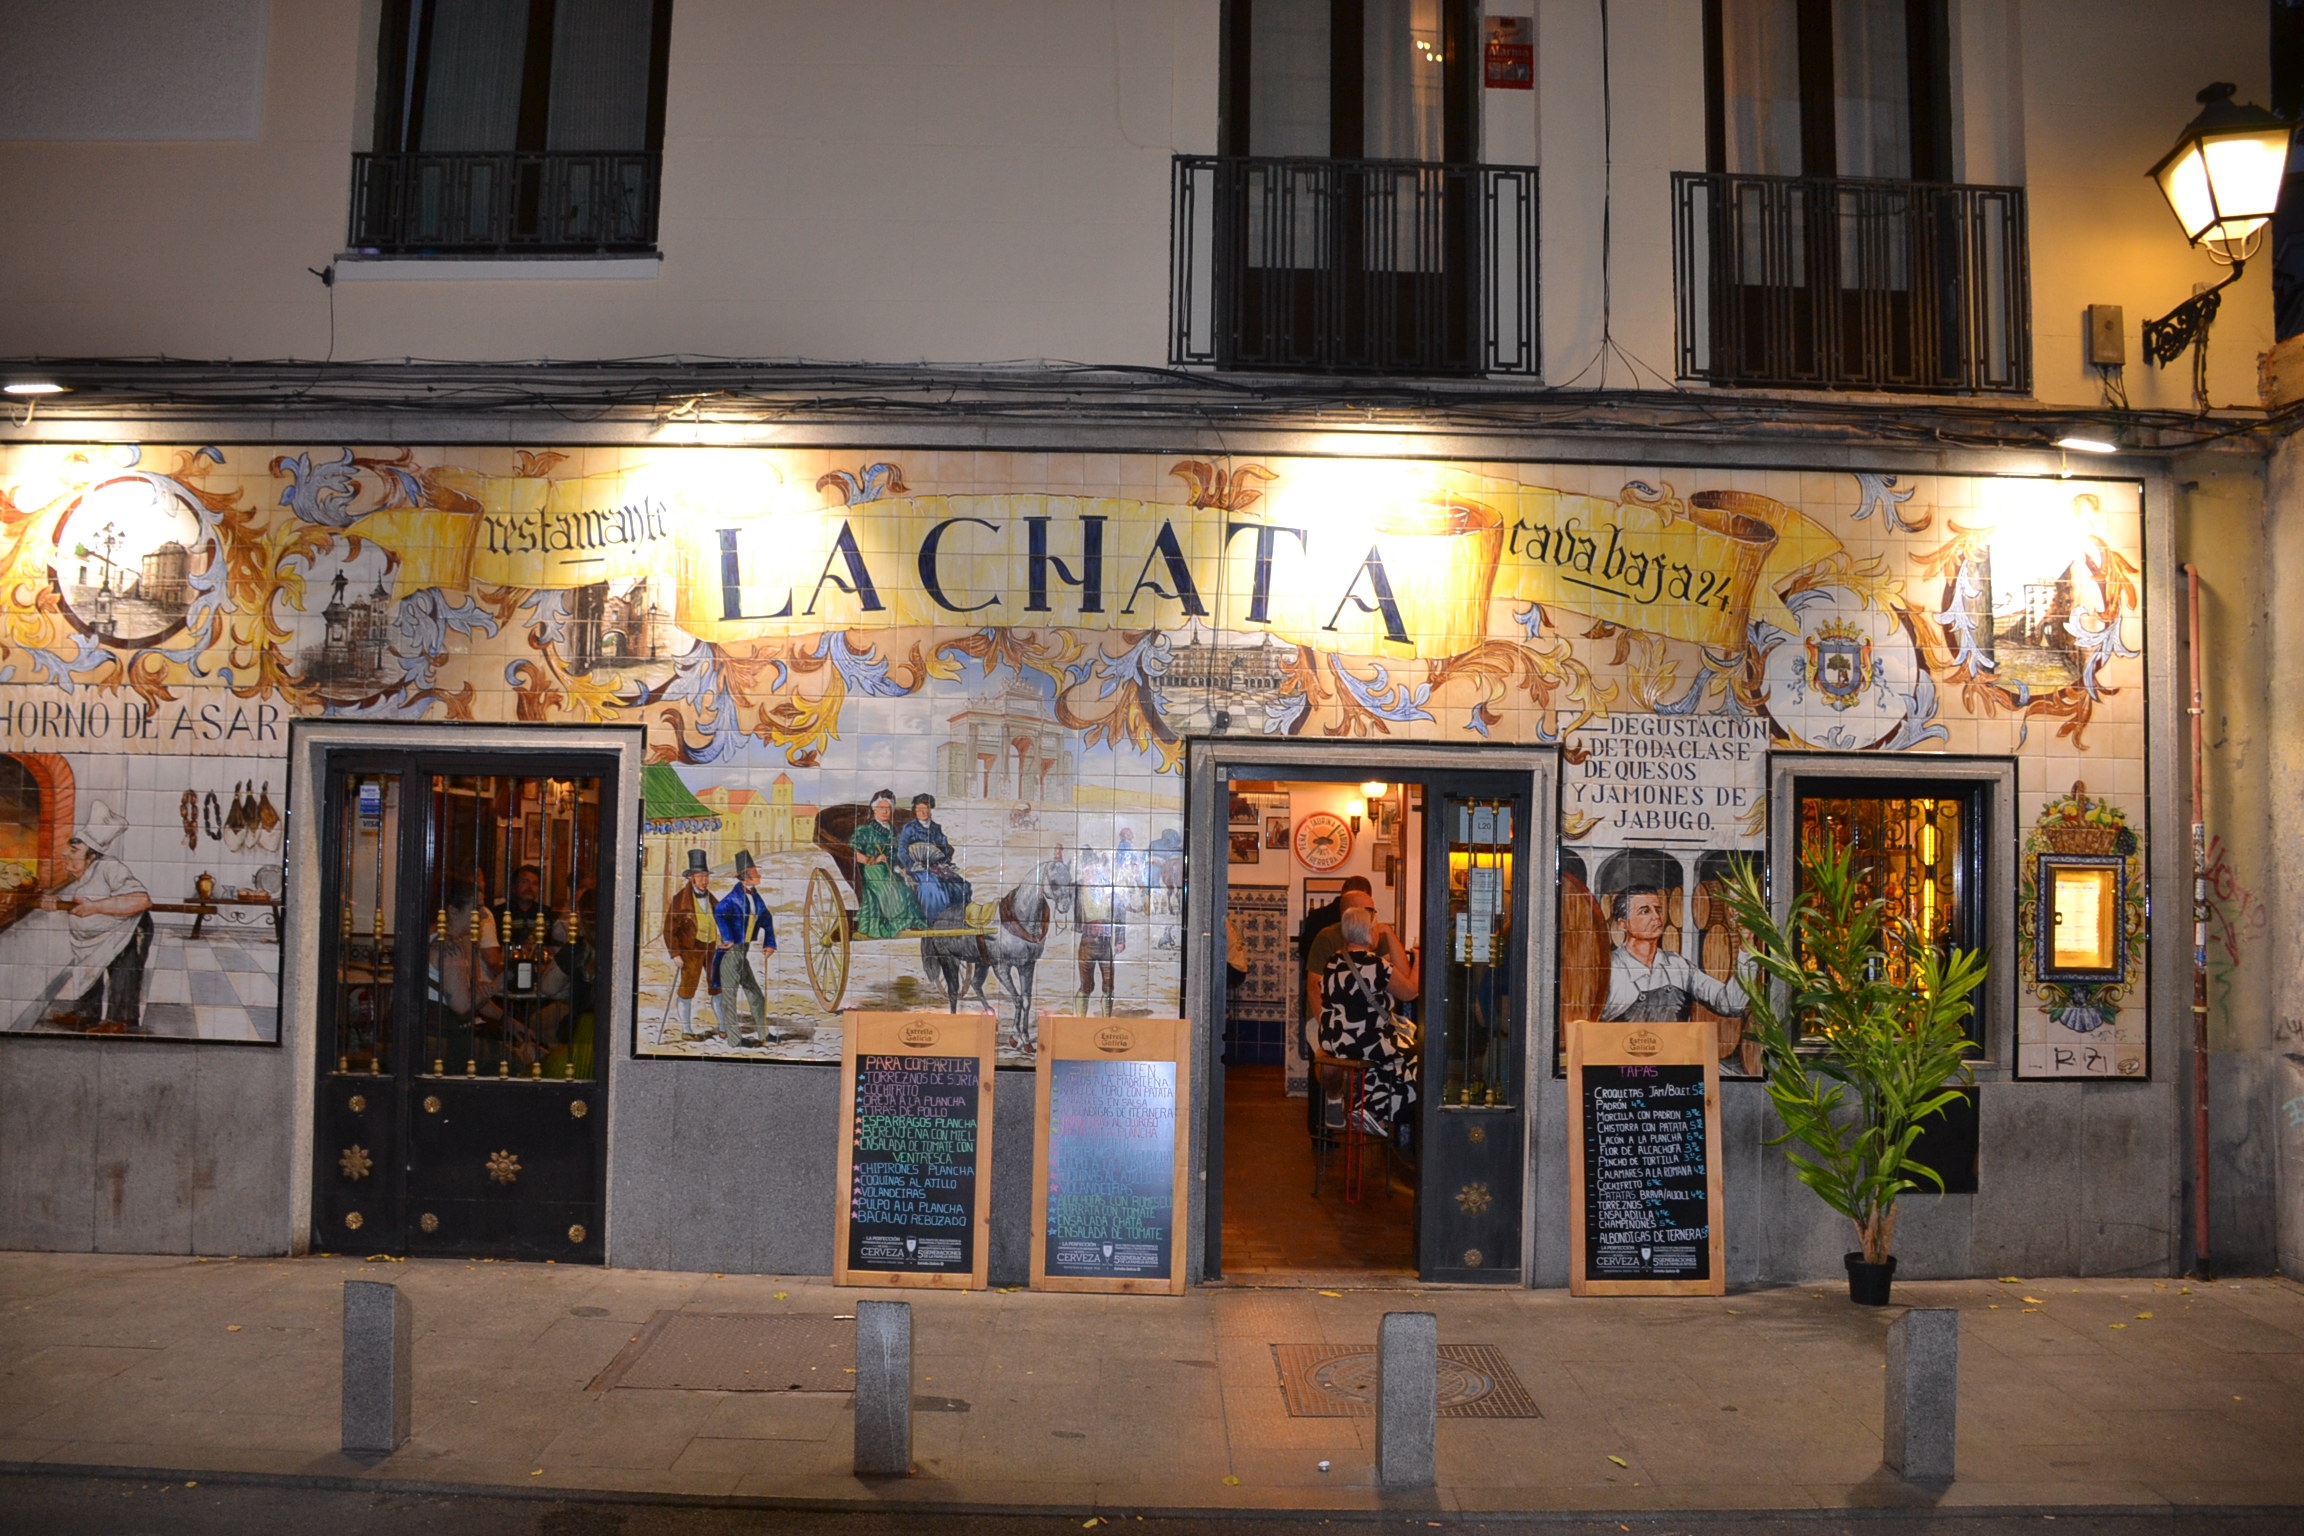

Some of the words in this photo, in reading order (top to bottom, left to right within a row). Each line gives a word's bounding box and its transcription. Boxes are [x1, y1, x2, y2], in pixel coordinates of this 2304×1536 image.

[1601, 522, 1693, 604] baja
[716, 519, 886, 621] LA
[918, 515, 1414, 645] CHATA
[122, 702, 159, 740] DE
[170, 704, 279, 742] ASAR
[1611, 716, 1768, 740] DEGUSTACIÓN
[1589, 738, 1616, 758] DE
[1619, 739, 1677, 760] TODA
[1679, 740, 1751, 762] CLASE
[1584, 760, 1612, 779] DE
[1615, 761, 1697, 781] QUESOS
[1571, 784, 1588, 803] Y
[1591, 785, 1705, 806] JAMONES
[1717, 787, 1747, 807] DE
[1613, 810, 1716, 831] JABUGO.
[865, 1056, 902, 1071] PARA
[904, 1057, 972, 1073] COMPARTIR
[1105, 1062, 1156, 1078] GLUTEN
[864, 1071, 928, 1085] TORREZNOS
[930, 1073, 944, 1085] DE
[1618, 1065, 1658, 1078] TAPAS
[864, 1083, 919, 1096] COCHIFRITO
[1101, 1085, 1123, 1098] TORO
[1126, 1086, 1141, 1098] CON
[1143, 1087, 1174, 1099] PATATA
[1594, 1086, 1644, 1099] CROQUETAS
[863, 1095, 896, 1106] OREJA
[899, 1096, 906, 1106] A
[908, 1096, 920, 1106] LA
[923, 1096, 966, 1107] PLANCHA
[1123, 1098, 1148, 1107] SALSA
[1596, 1098, 1627, 1111] PADRÓN
[862, 1106, 896, 1117] TIRAS
[899, 1106, 914, 1117] DE
[917, 1106, 948, 1117] POLLO
[1116, 1107, 1126, 1118] DE
[1596, 1111, 1634, 1122] MORCILLA
[1637, 1110, 1651, 1120] CON
[862, 1115, 932, 1128] ESPARRAGOS
[935, 1118, 977, 1129] PLANCHA
[1597, 1121, 1639, 1133] CHISTORRA
[1641, 1122, 1656, 1132] CON
[1659, 1122, 1688, 1132] PATATA
[862, 1126, 929, 1140] BERENJENA
[931, 1128, 948, 1140] CON
[951, 1130, 975, 1141] MIEL
[1599, 1133, 1624, 1146] LACÓN
[1628, 1136, 1634, 1144] A
[1638, 1135, 1647, 1144] LA
[1650, 1132, 1683, 1143] PLANCHA
[860, 1138, 906, 1151] ENSALADA
[908, 1141, 920, 1151] DE
[922, 1141, 955, 1152] TOMATE
[956, 1142, 974, 1152] CON
[1599, 1145, 1618, 1156] FLOR
[1621, 1145, 1633, 1155] DE
[1638, 1143, 1682, 1154] ALCACHOFA
[892, 1152, 953, 1164] VENTRESCA
[1598, 1156, 1627, 1167] PINCHO
[1629, 1157, 1639, 1166] DE
[1642, 1154, 1680, 1166] TORTILLA
[860, 1162, 919, 1175] CHIPIRONES
[928, 1165, 975, 1176] PLANCHA
[1597, 1167, 1644, 1180] CALAMARES
[1645, 1168, 1652, 1178] A
[1652, 1168, 1663, 1178] LA
[1663, 1165, 1693, 1177] ROMANA
[860, 1175, 905, 1187] COQUINAS
[909, 1178, 921, 1187] AL
[1597, 1180, 1643, 1191] COCHIFRITO
[860, 1186, 926, 1199] VOLANDEIRAS
[1599, 1190, 1637, 1201] PATATAS
[858, 1198, 890, 1210] PULPO
[894, 1200, 901, 1211] A
[903, 1201, 914, 1211] LA
[919, 1201, 964, 1214] PLANCHA
[1110, 1195, 1129, 1207] CON
[1597, 1200, 1643, 1210] TORREZNOS
[857, 1210, 907, 1225] BACALAO
[911, 1213, 967, 1226] REBOZADO
[1121, 1207, 1156, 1219] TOMATE
[1599, 1210, 1655, 1221] ENSALADILLA
[1058, 1215, 1108, 1228] ENSALADA
[1112, 1216, 1143, 1228] CHATA
[1058, 1226, 1108, 1239] ENSALADA
[1111, 1227, 1123, 1240] DE
[1127, 1228, 1163, 1240] TOMATE
[1599, 1230, 1652, 1244] ALBONDIGAS
[1653, 1229, 1666, 1243] DE
[860, 1247, 904, 1257] CERVEZA
[1056, 1253, 1100, 1263] CERVEZA
[1114, 1255, 1120, 1264] 5
[1596, 1256, 1640, 1266] CERVEZA
